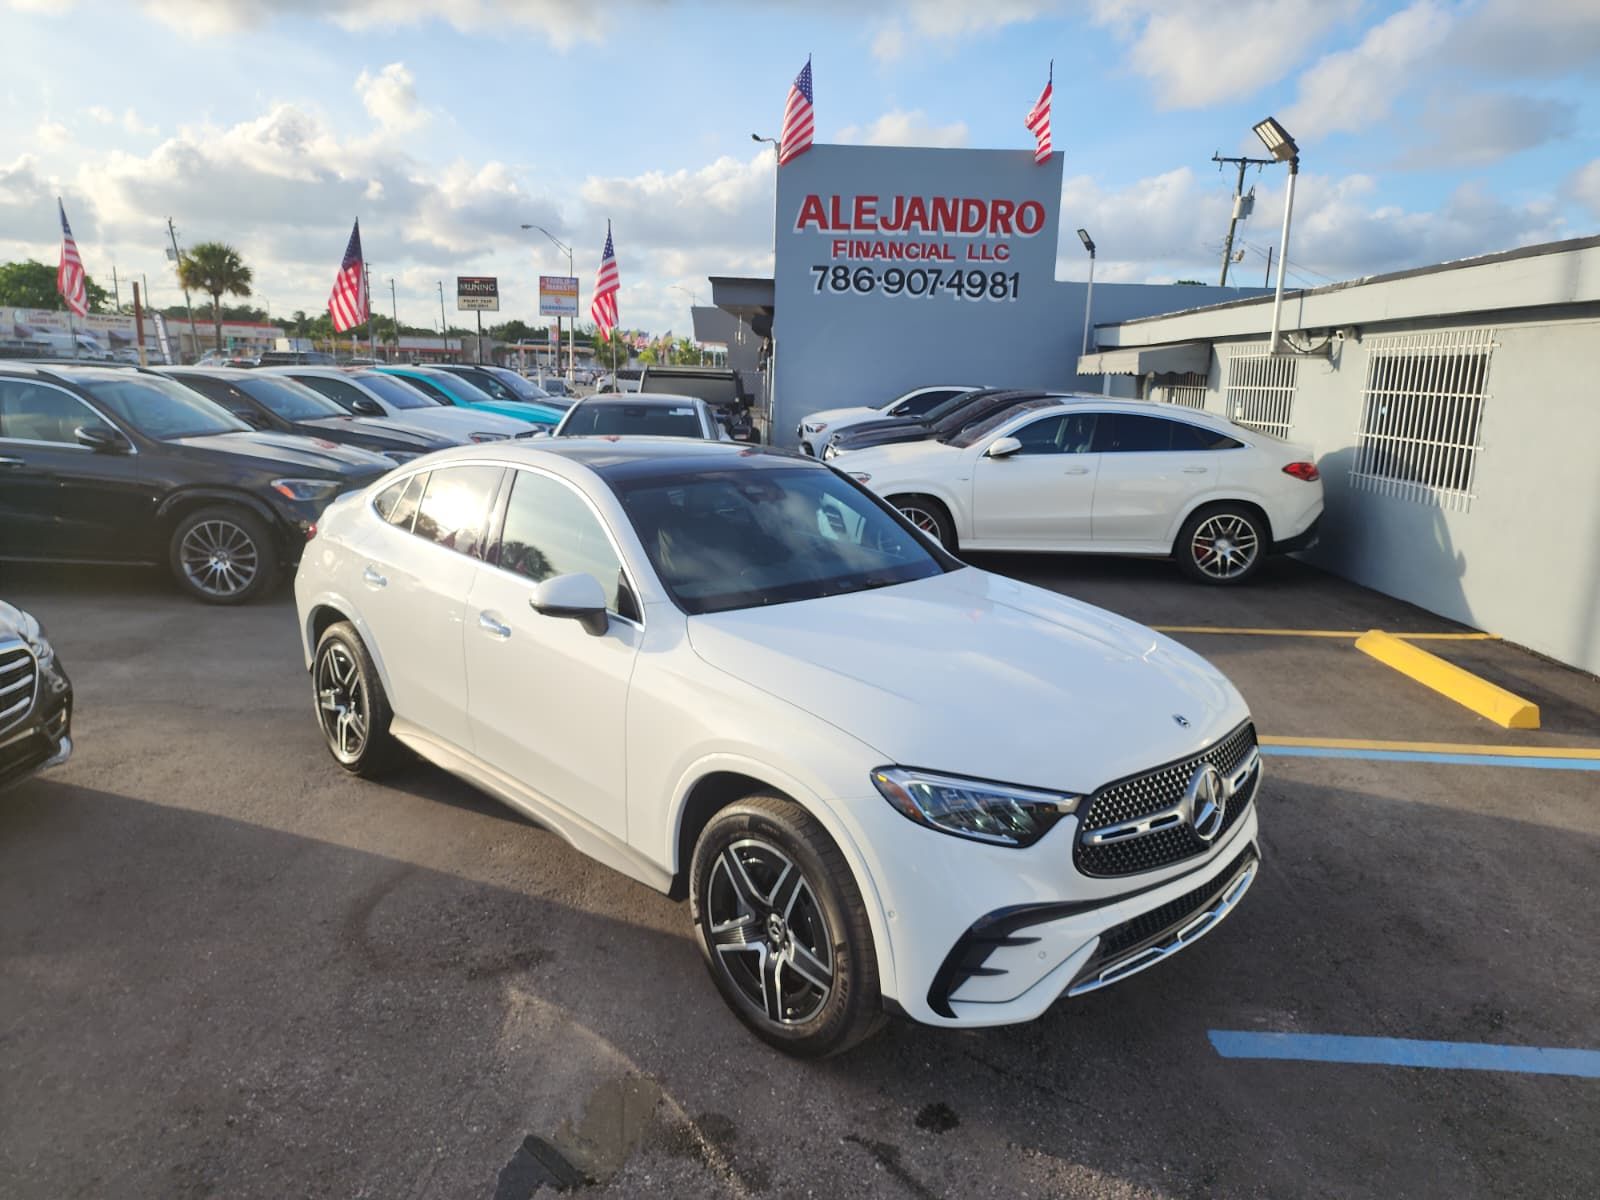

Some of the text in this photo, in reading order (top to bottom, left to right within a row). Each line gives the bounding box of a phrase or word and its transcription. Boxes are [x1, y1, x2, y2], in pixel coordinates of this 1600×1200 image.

[794, 194, 1046, 238] ALEJANDRO
[832, 239, 1010, 264] FINANCIAL LLC
